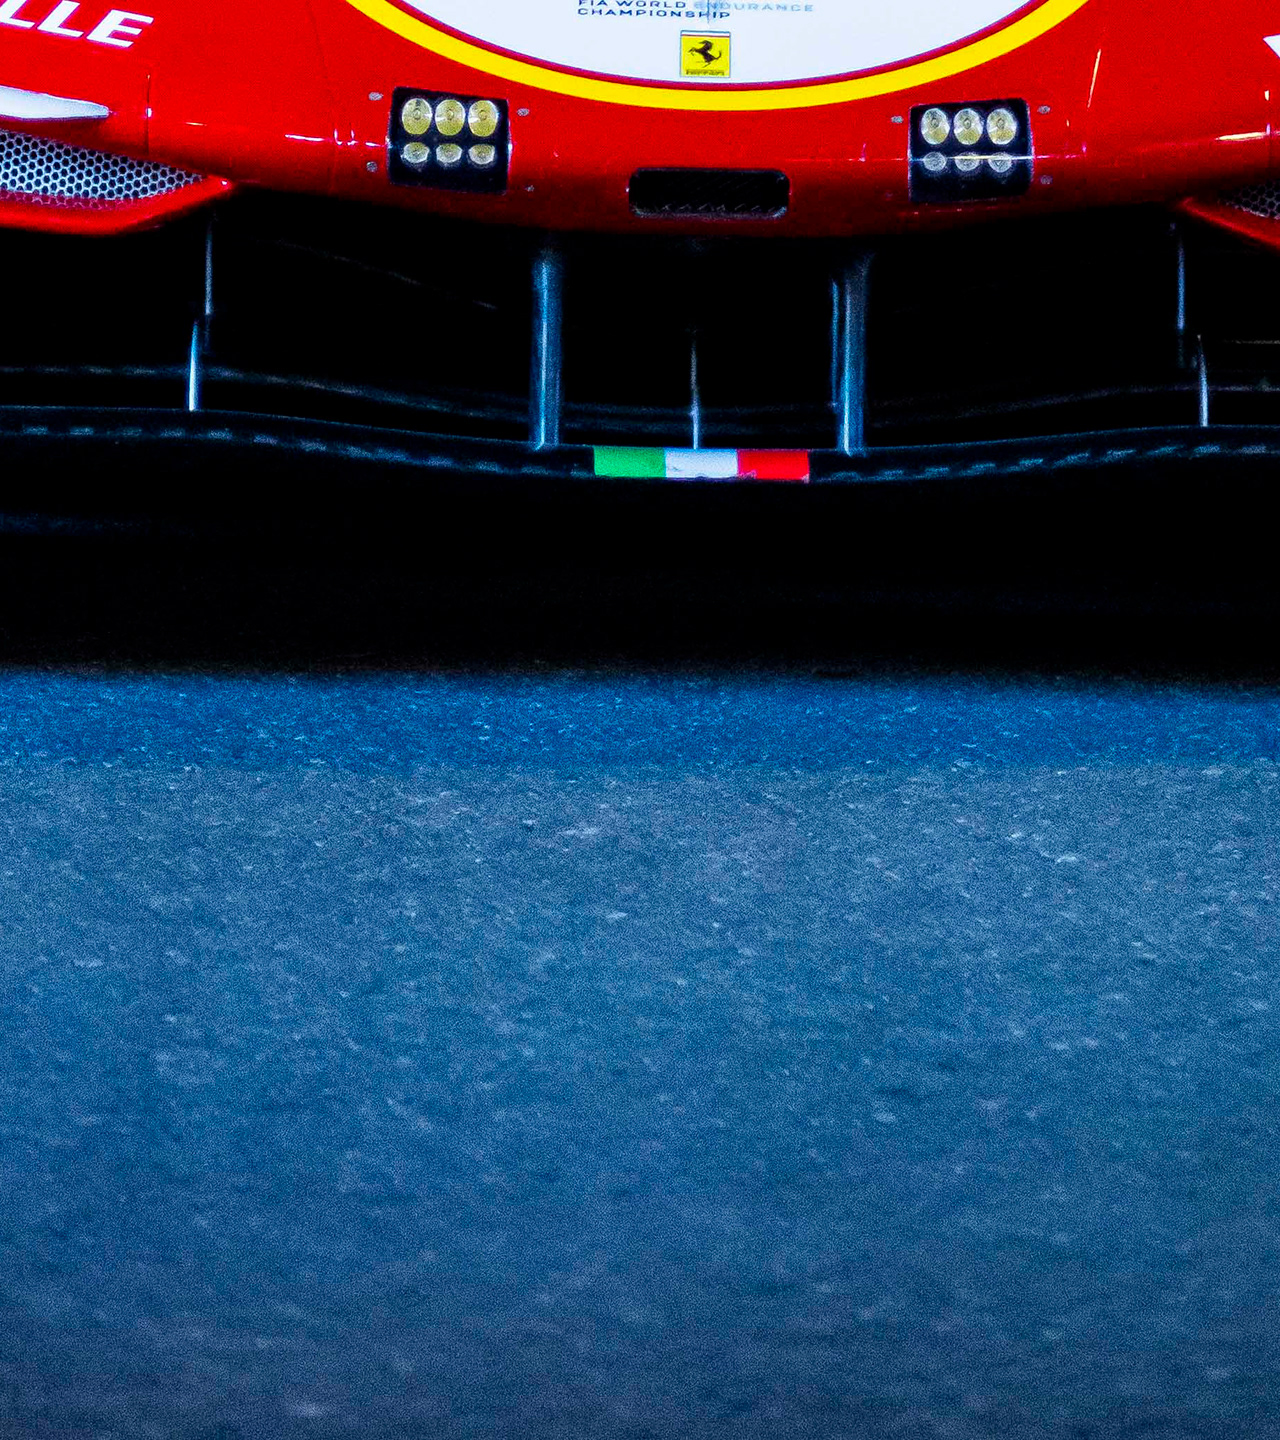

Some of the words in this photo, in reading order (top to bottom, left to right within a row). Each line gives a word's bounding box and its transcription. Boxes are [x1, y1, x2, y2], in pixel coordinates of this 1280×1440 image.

[615, 0, 687, 8] WORLD
[693, 1, 815, 12] ENDURANCE
[577, 7, 731, 19] CHAMPIONSHIP
